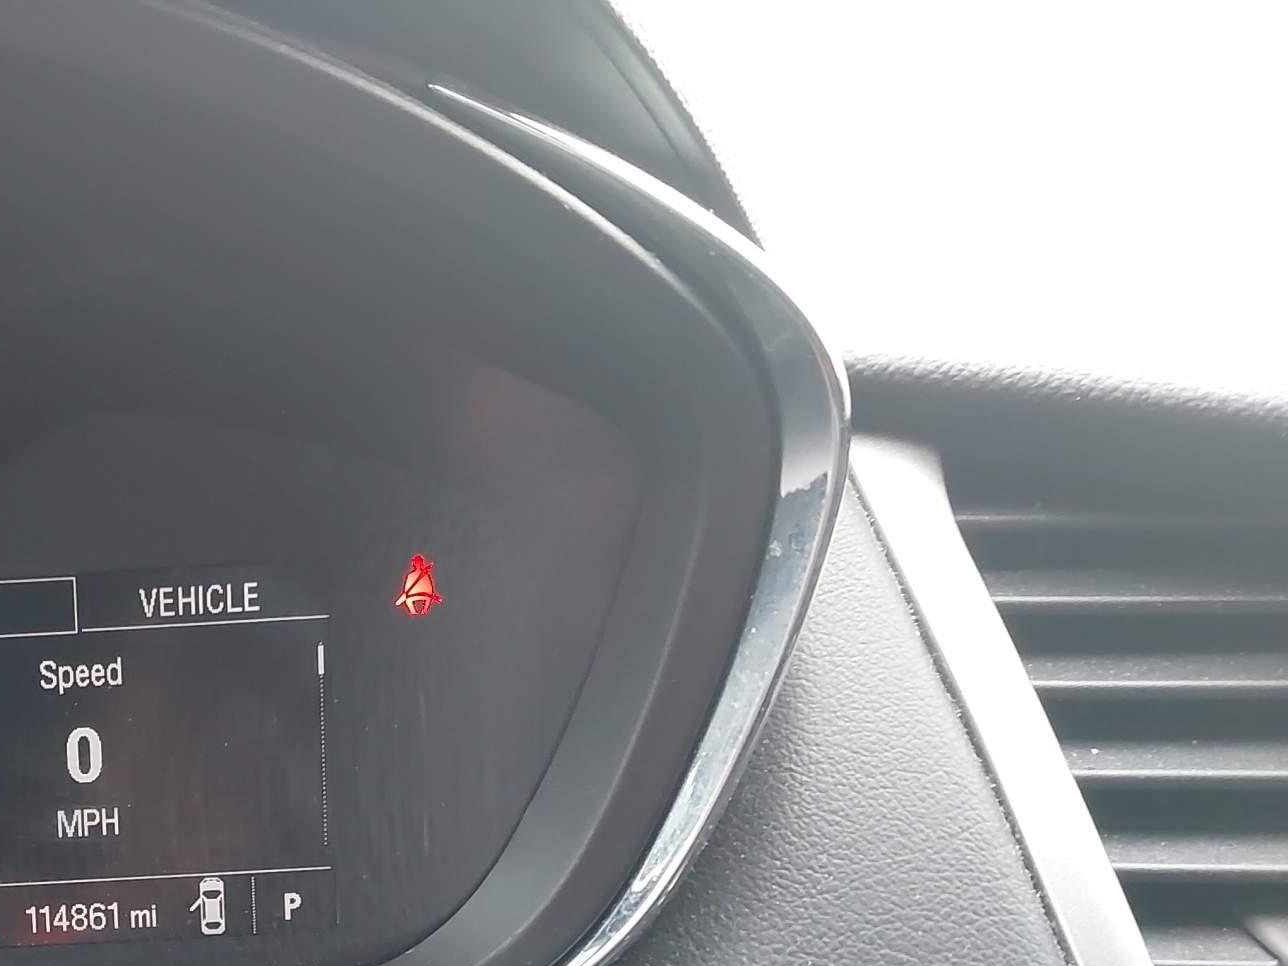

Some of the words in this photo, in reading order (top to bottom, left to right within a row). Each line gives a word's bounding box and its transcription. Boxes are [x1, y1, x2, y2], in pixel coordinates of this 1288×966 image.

[140, 582, 261, 618] VEHICLE
[39, 658, 122, 695] Speed
[66, 728, 102, 783] 0
[57, 808, 119, 839] MPH
[25, 903, 121, 935] 114861
[130, 905, 157, 929] mi
[284, 893, 300, 921] P
